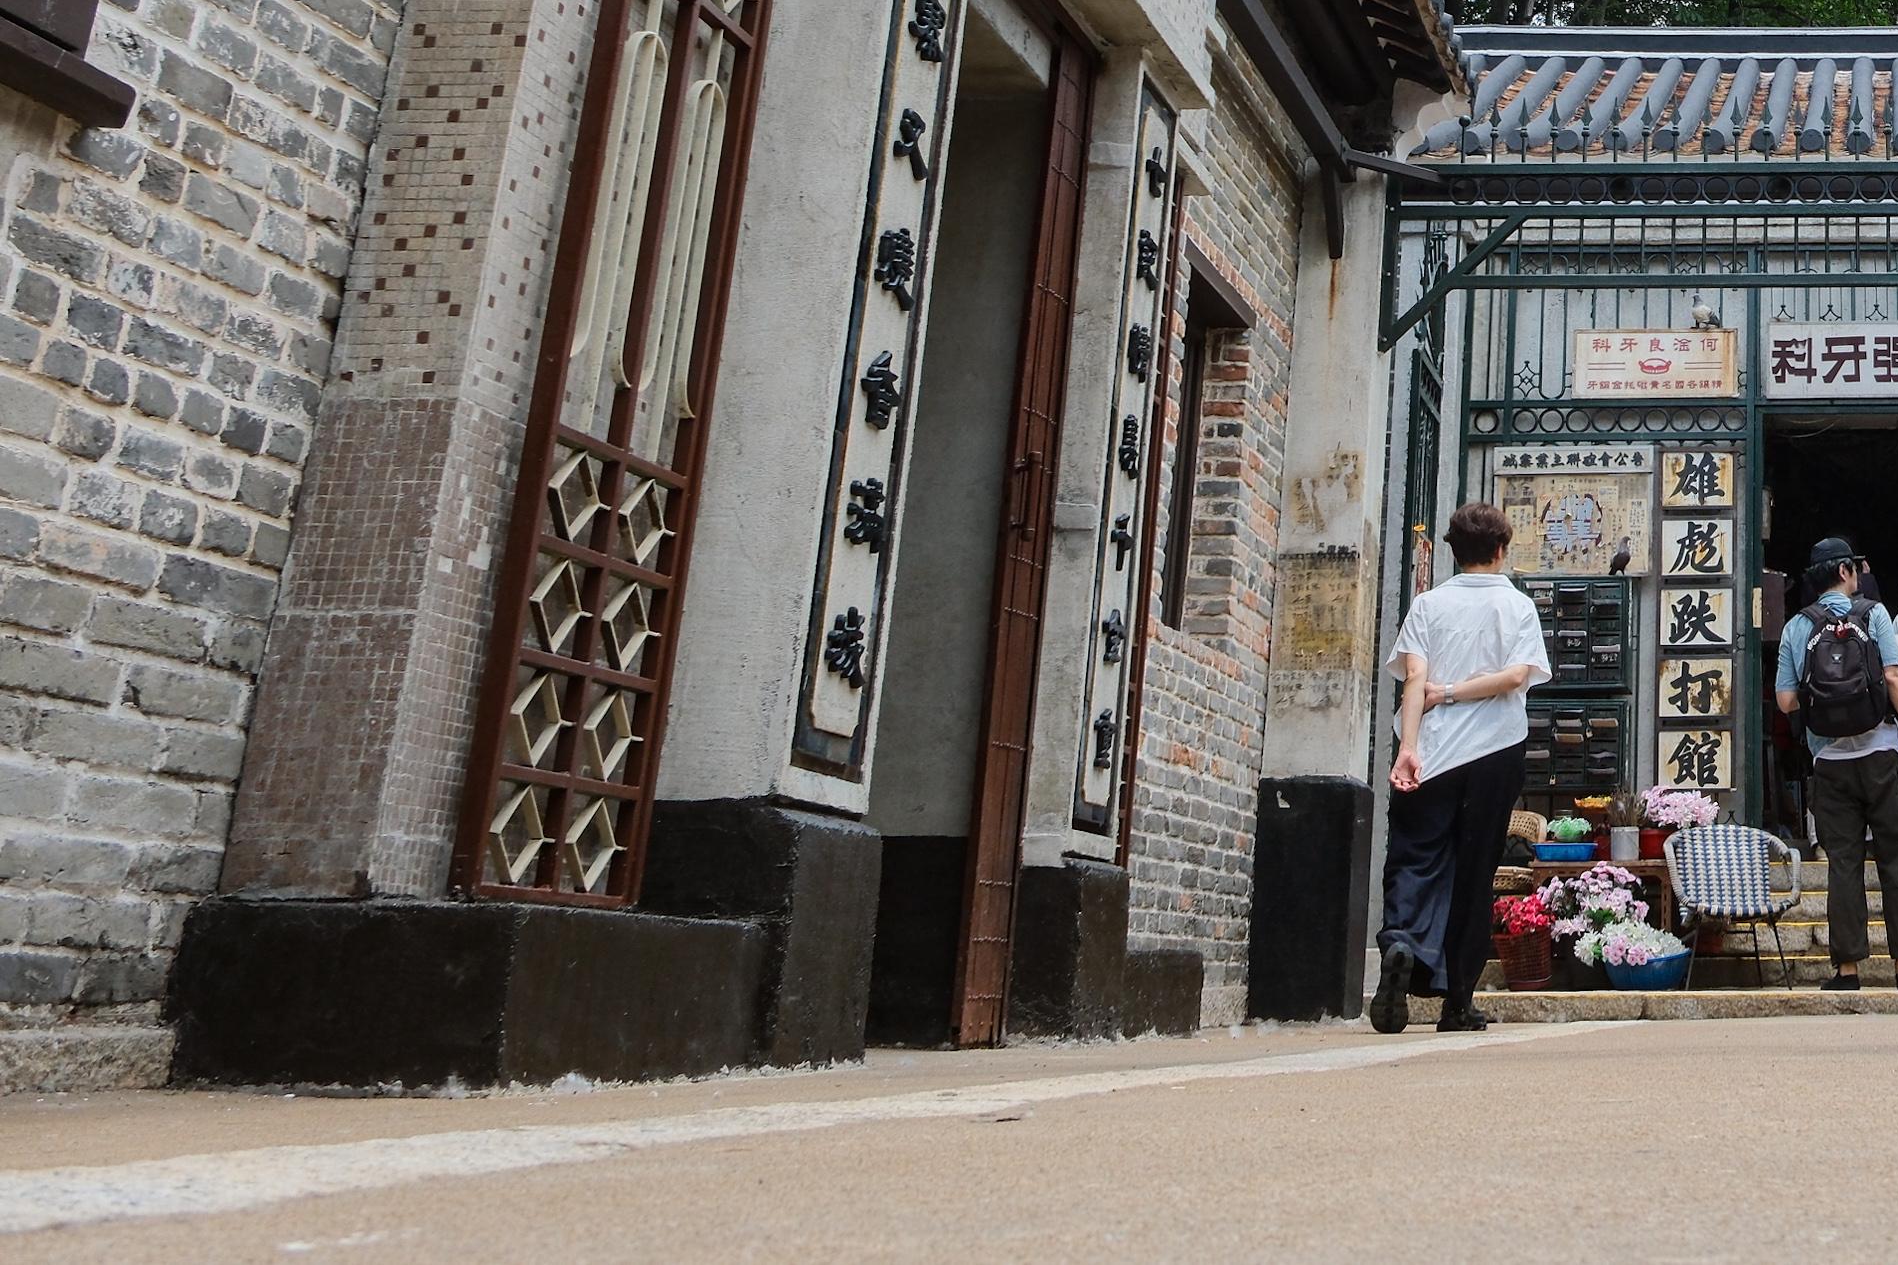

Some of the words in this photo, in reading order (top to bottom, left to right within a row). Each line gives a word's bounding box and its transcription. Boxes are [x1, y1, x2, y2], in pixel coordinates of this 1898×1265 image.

[1667, 452, 1728, 788] 雄彪跌打館
